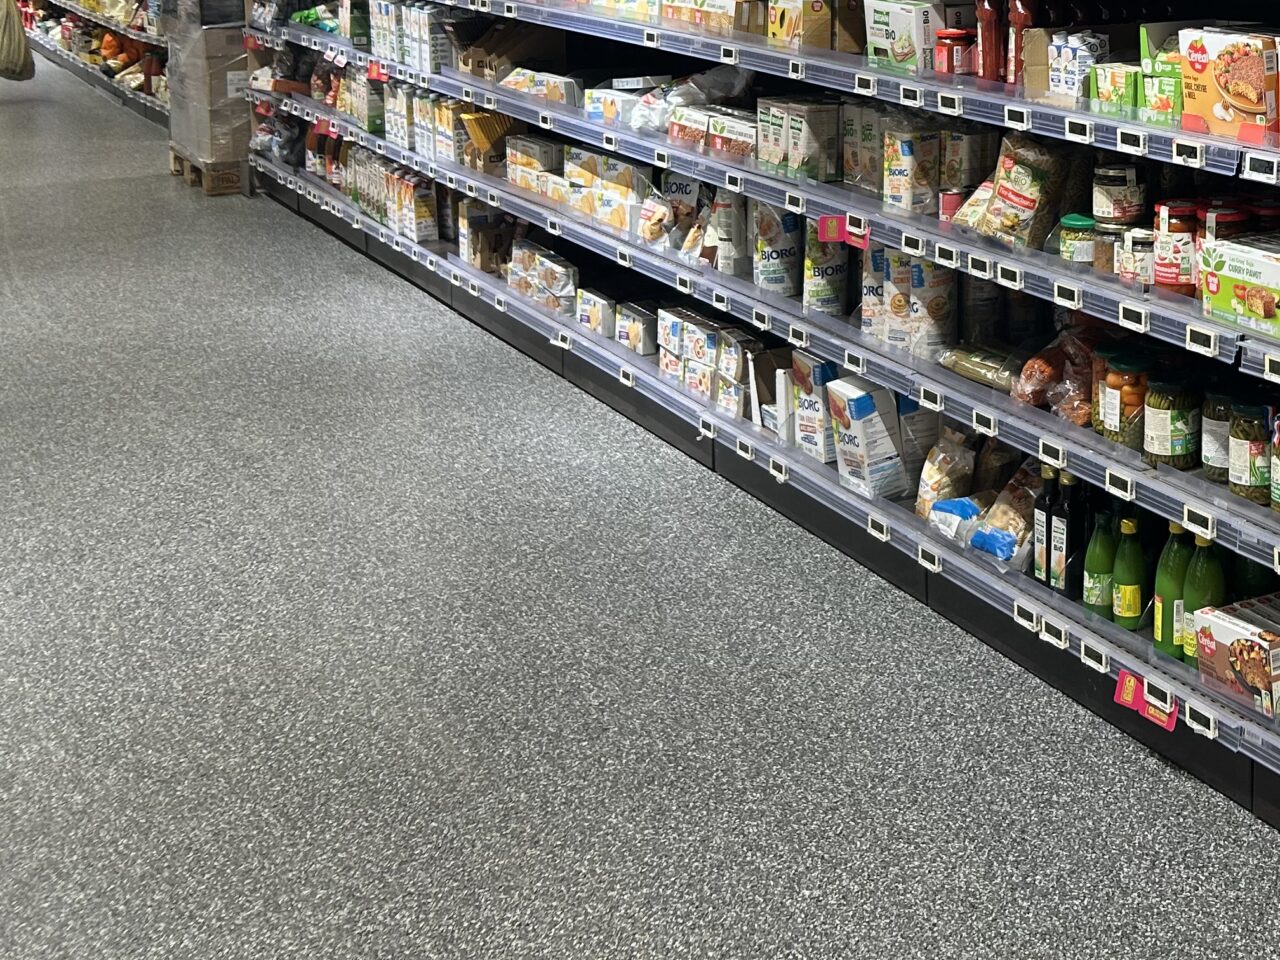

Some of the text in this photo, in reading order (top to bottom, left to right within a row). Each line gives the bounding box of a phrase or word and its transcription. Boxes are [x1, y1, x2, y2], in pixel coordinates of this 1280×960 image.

[1186, 48, 1209, 63] Céréal
[1228, 265, 1262, 280] CURRY PAVOT
[1198, 633, 1216, 650] Céréal
